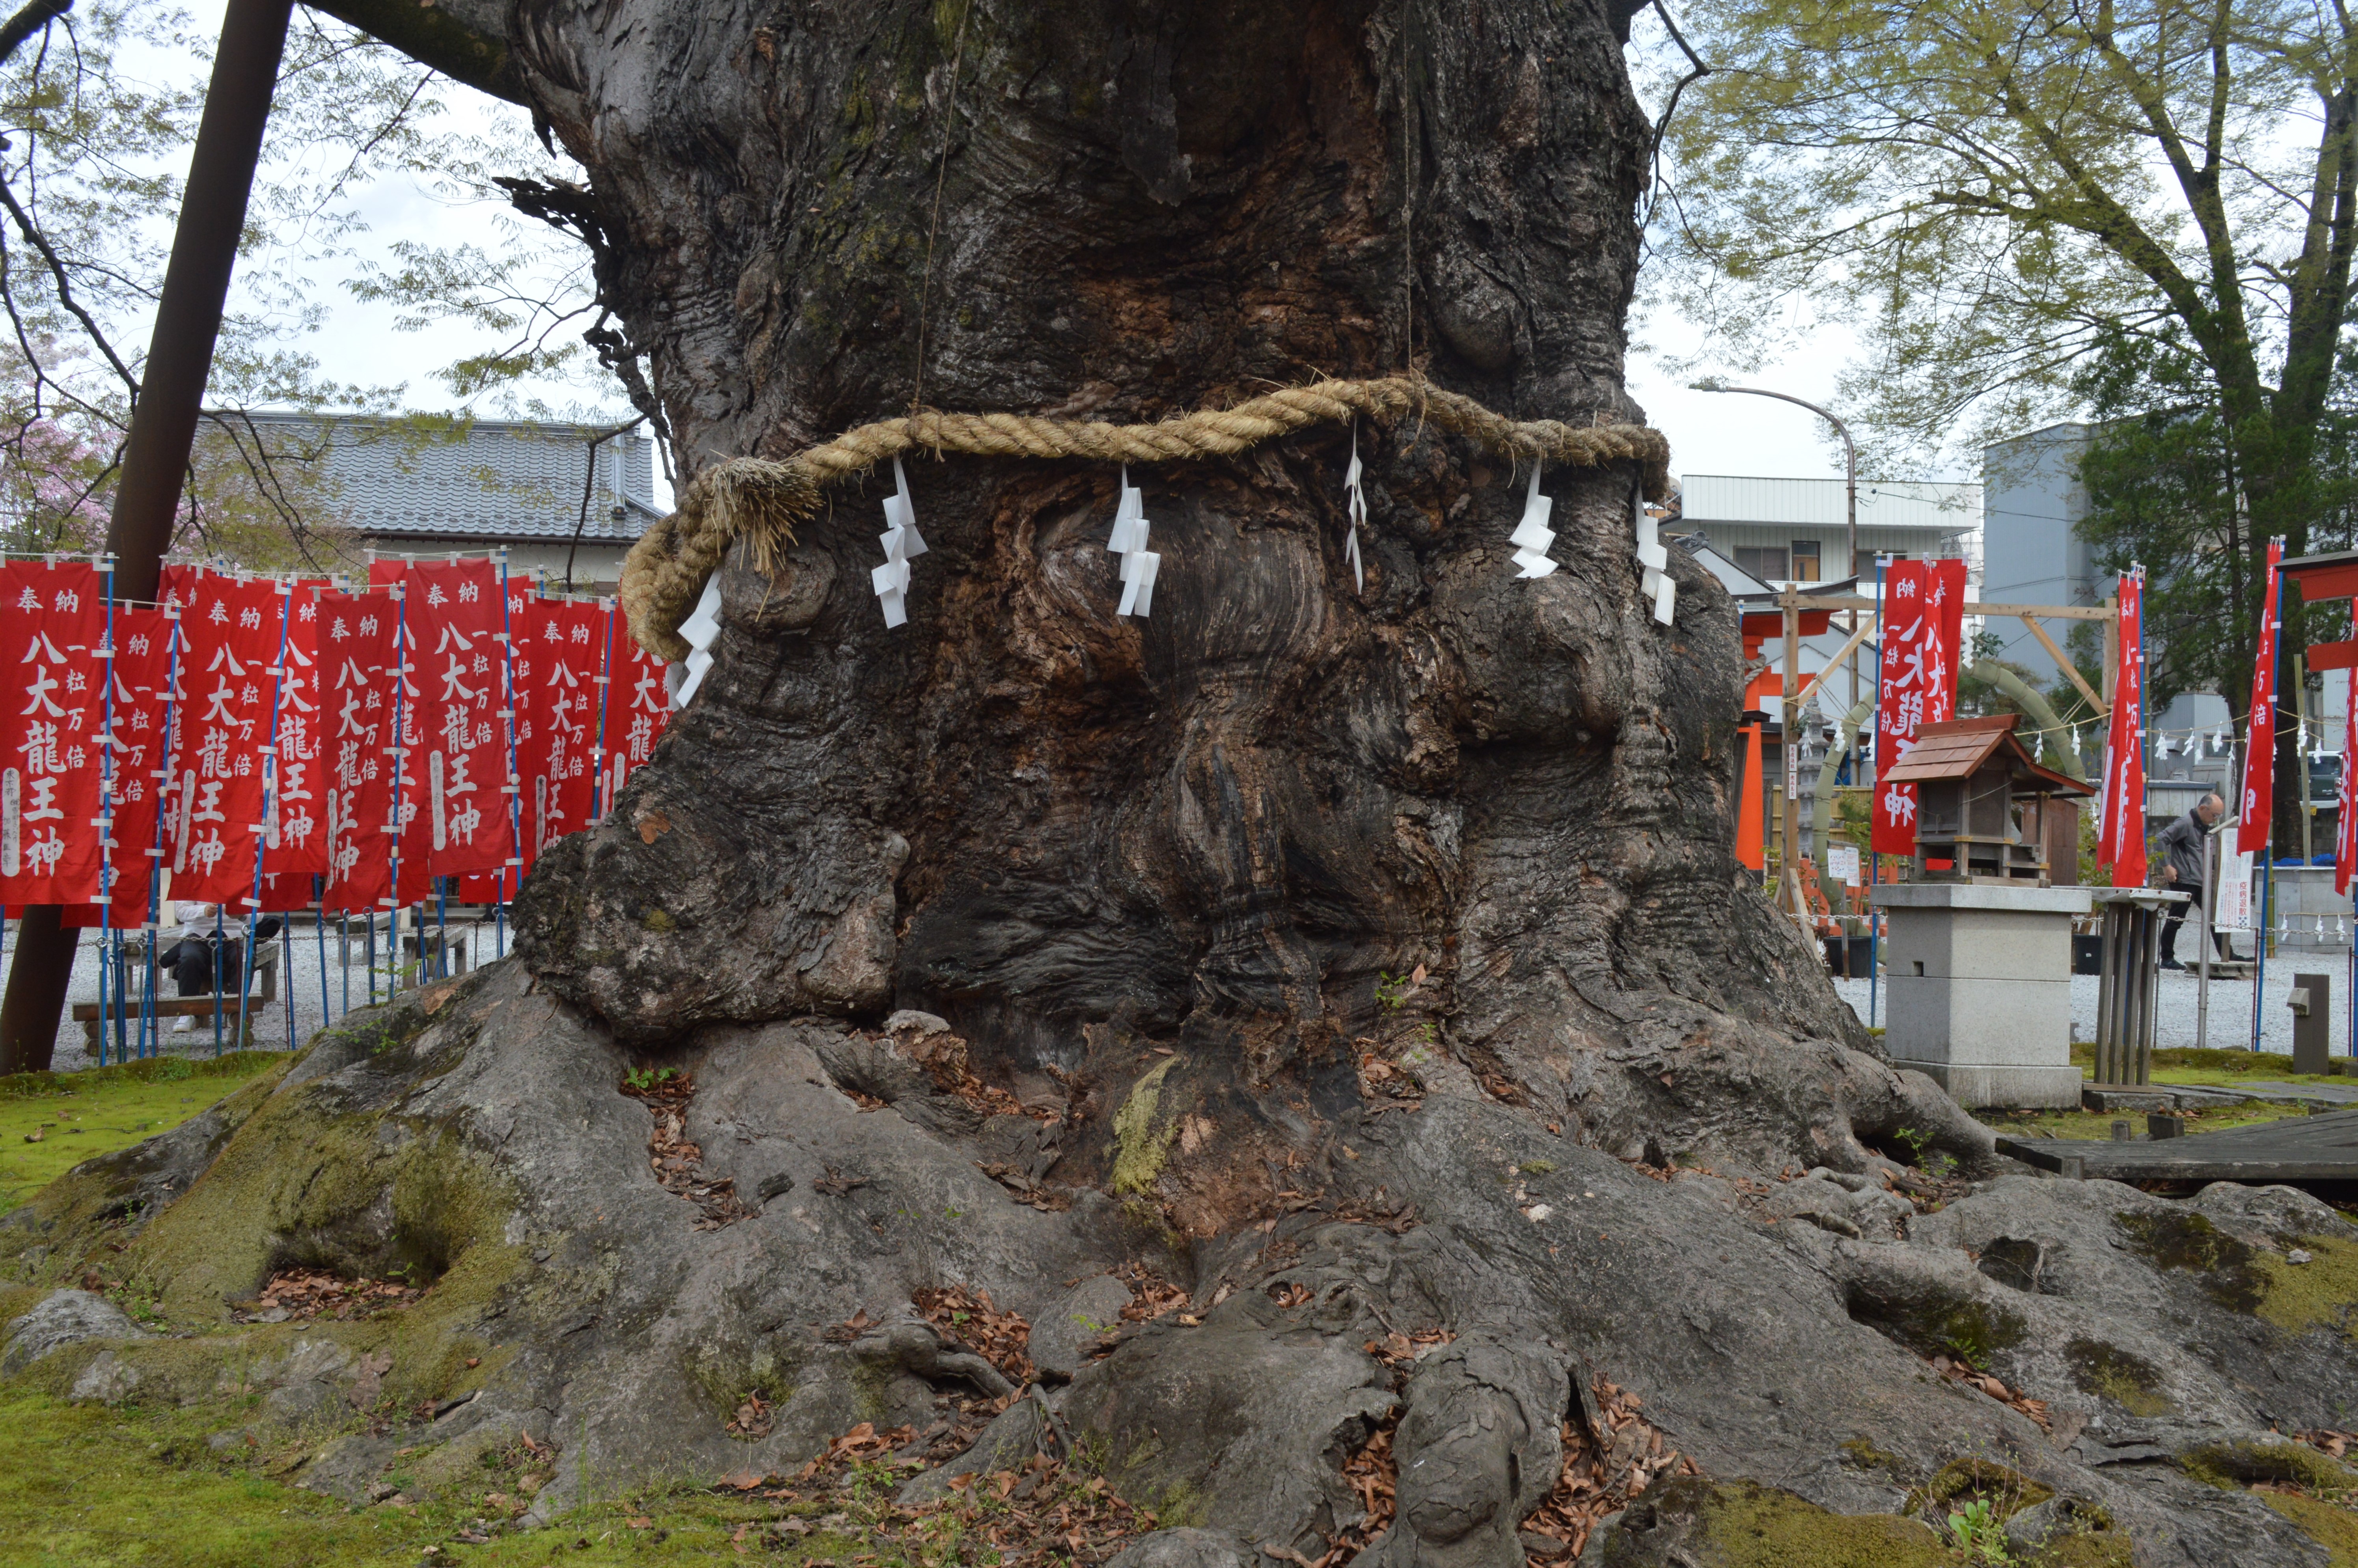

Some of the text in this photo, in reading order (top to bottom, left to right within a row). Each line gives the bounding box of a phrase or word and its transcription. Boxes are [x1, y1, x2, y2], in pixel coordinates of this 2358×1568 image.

[17, 585, 78, 614] 奉納
[209, 599, 261, 630] 奉納
[331, 614, 378, 643] 奉納
[427, 580, 478, 609] 奉納
[544, 620, 589, 644] 奉納
[66, 645, 86, 770] 一粒万倍
[126, 686, 152, 802] 一粒万倍
[234, 660, 261, 776] 一粒万倍
[274, 638, 313, 850] 八大龍王神
[362, 666, 382, 780] 一粒万倍
[434, 622, 481, 846] 八大龍王神
[472, 631, 492, 744] 一粒万倍
[517, 639, 532, 739] 一粒万倍
[569, 671, 590, 776] 一粒万倍
[625, 647, 663, 768] 八大龍
[17, 630, 67, 877] 八大龍王神
[190, 642, 245, 877] 八大龍王神
[334, 656, 368, 882] 八大龍王神
